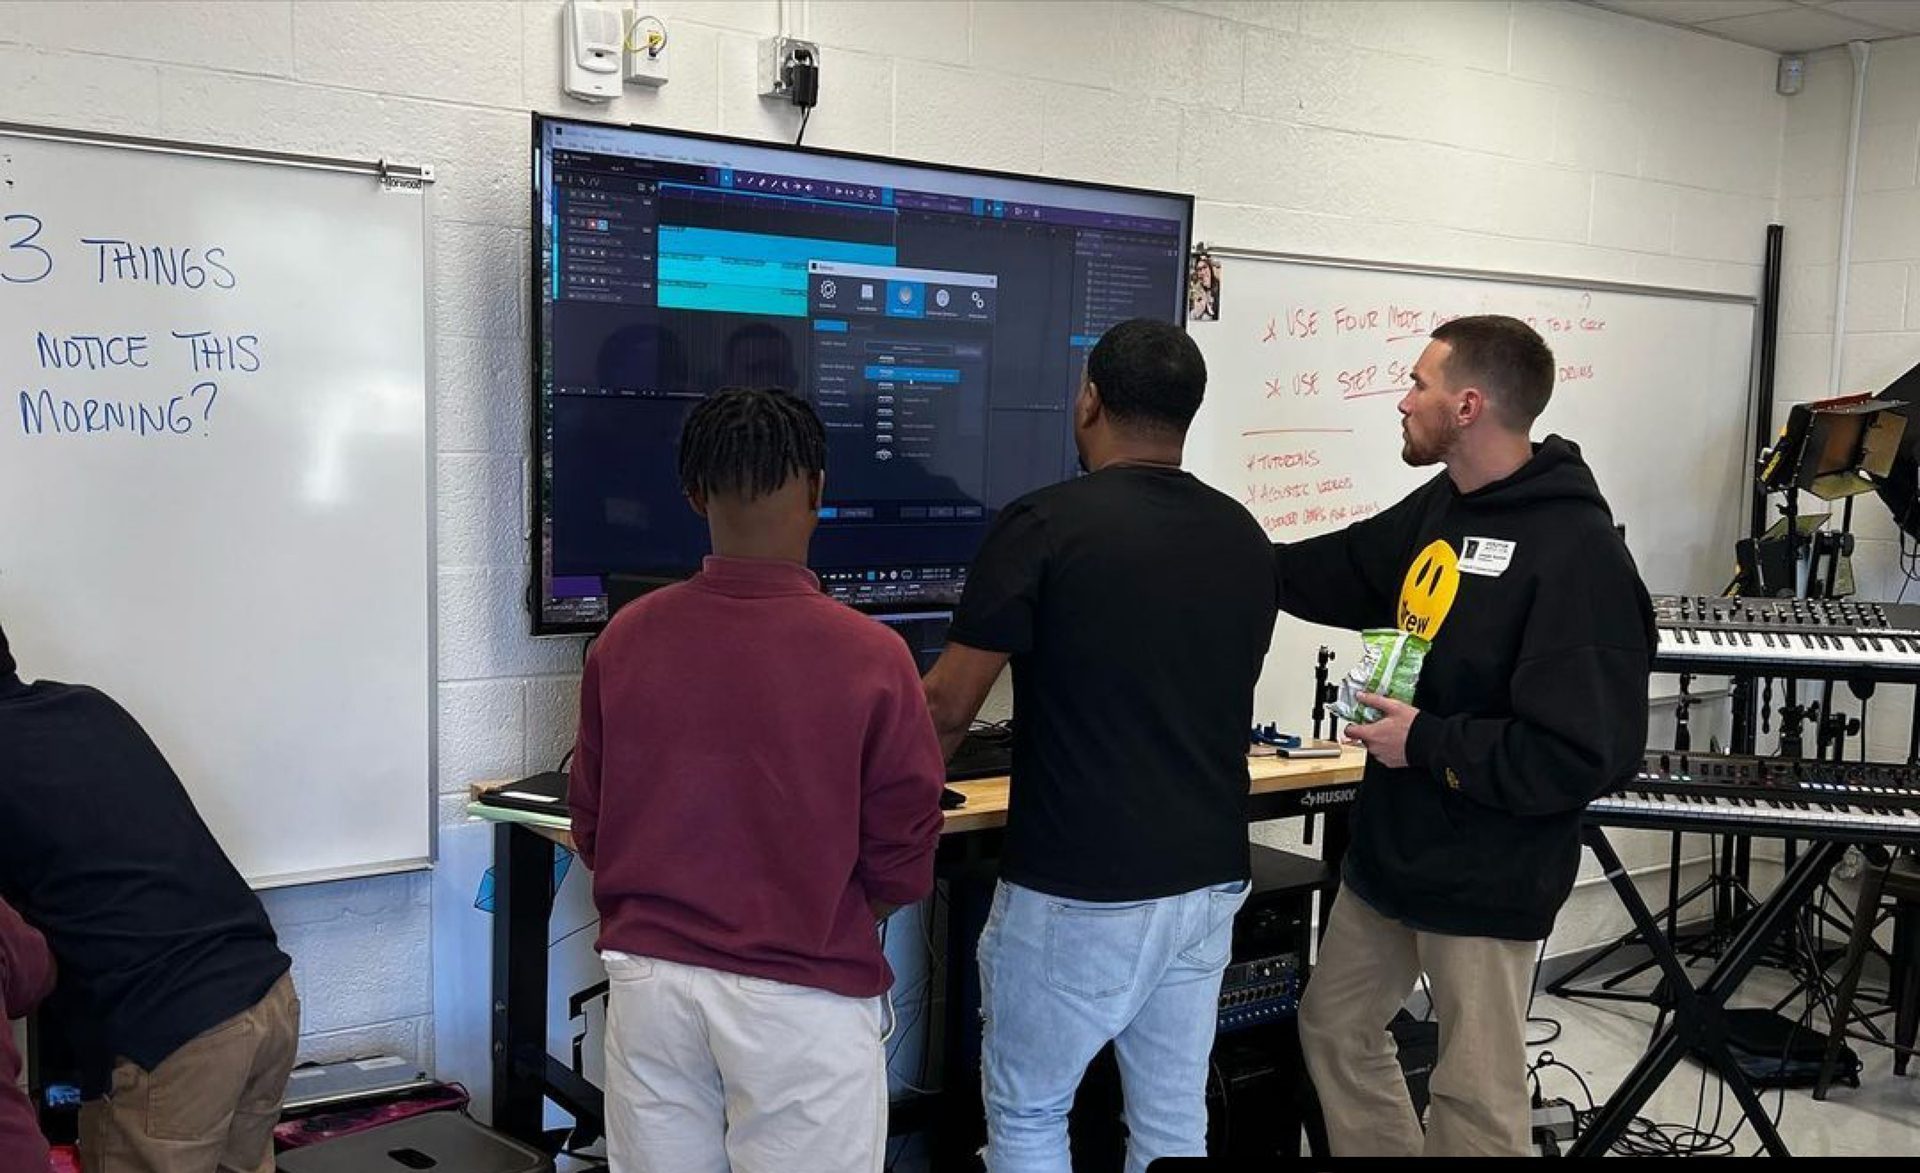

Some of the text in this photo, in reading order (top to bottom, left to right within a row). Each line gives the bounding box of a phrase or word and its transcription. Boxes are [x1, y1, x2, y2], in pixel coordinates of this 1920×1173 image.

[1, 214, 237, 289] 3 THINGS
[1286, 304, 1318, 338] USE
[1334, 306, 1379, 335] FOUR
[37, 331, 262, 372] NOTICE THIS
[1293, 370, 1320, 396] USE
[1336, 365, 1377, 393] STEP
[19, 382, 218, 437] MORNING?
[1316, 788, 1357, 804] HUSKY
